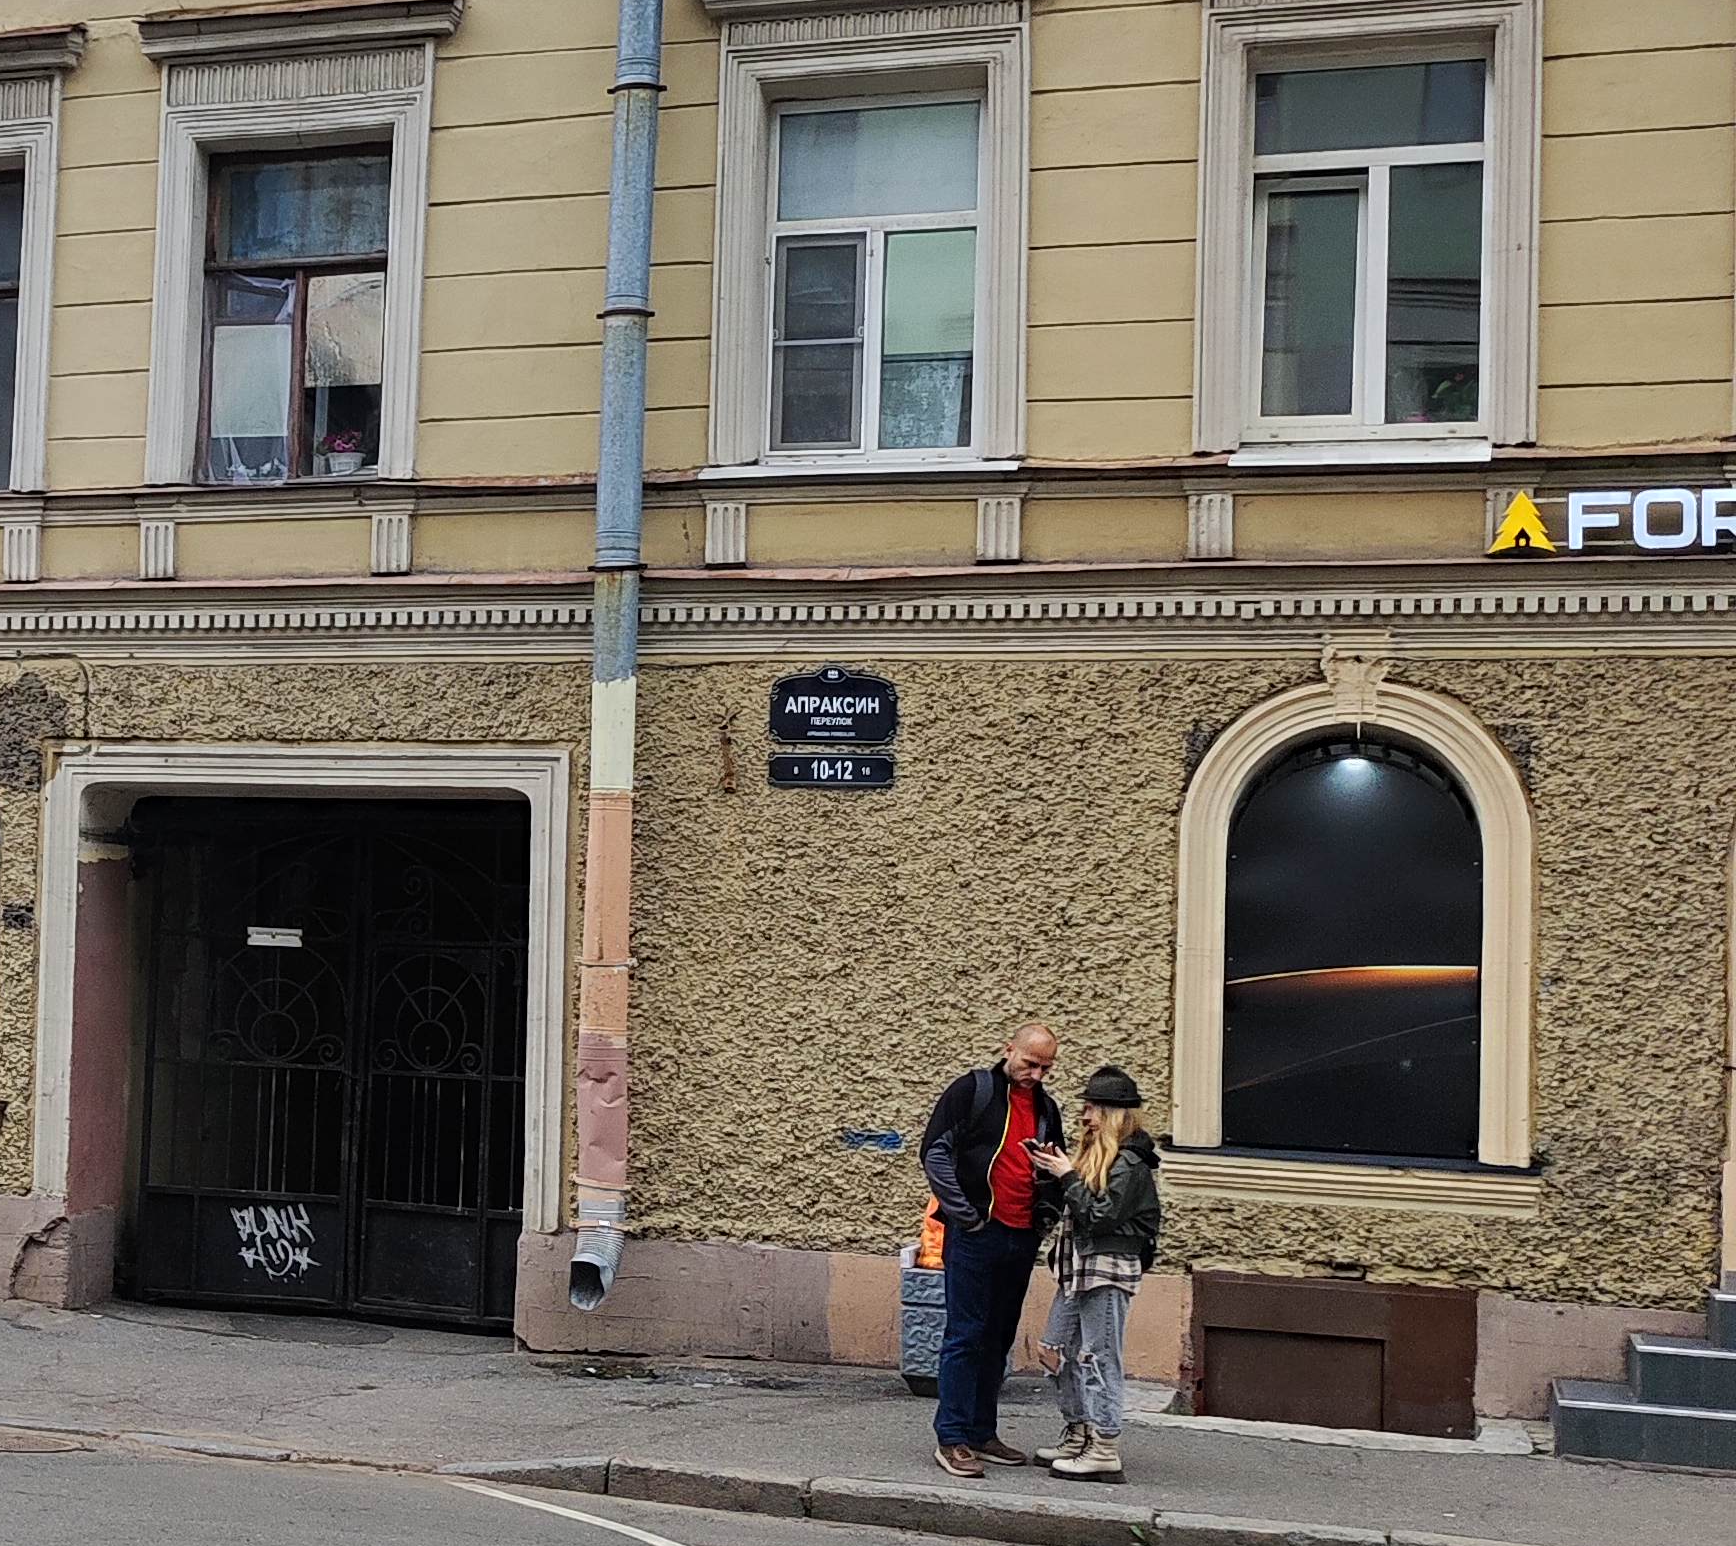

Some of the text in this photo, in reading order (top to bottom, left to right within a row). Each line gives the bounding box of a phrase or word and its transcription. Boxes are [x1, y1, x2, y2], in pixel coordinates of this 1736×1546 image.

[784, 696, 880, 714] АПРАКСИН
[810, 716, 853, 726] ПЕРЕУЛОК
[810, 759, 853, 780] 10-12
